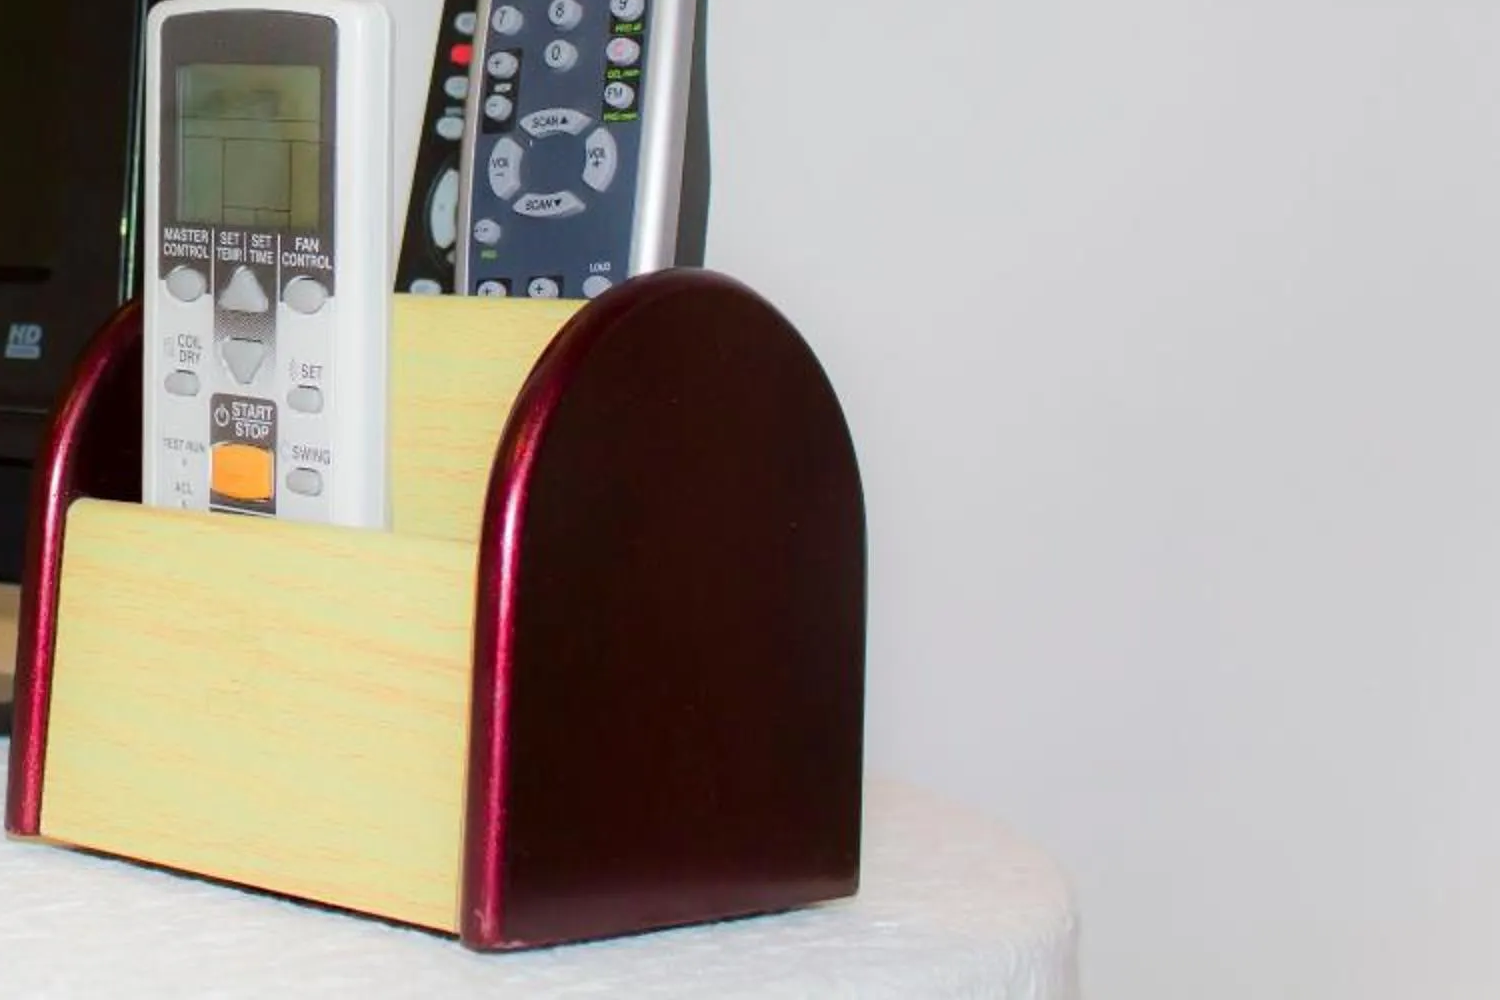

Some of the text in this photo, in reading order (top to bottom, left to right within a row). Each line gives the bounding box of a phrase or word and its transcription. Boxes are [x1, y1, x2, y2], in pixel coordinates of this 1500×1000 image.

[551, 45, 561, 61] 0
[531, 115, 560, 129] SCAN
[588, 146, 606, 160] VOL
[491, 157, 510, 169] VOL
[525, 197, 554, 212] SCAN
[163, 227, 209, 244] MASTER
[219, 231, 240, 245] SET
[251, 233, 273, 248] SET
[163, 243, 211, 259] CONTROL
[294, 236, 320, 252] FAN
[249, 249, 275, 264] TIME
[281, 251, 333, 270] CONTROL
[7, 323, 44, 345] HD
[179, 349, 201, 365] DRY
[301, 363, 323, 380] SET
[231, 401, 274, 420] START
[234, 421, 270, 440] STOP
[291, 445, 331, 465] SWING
